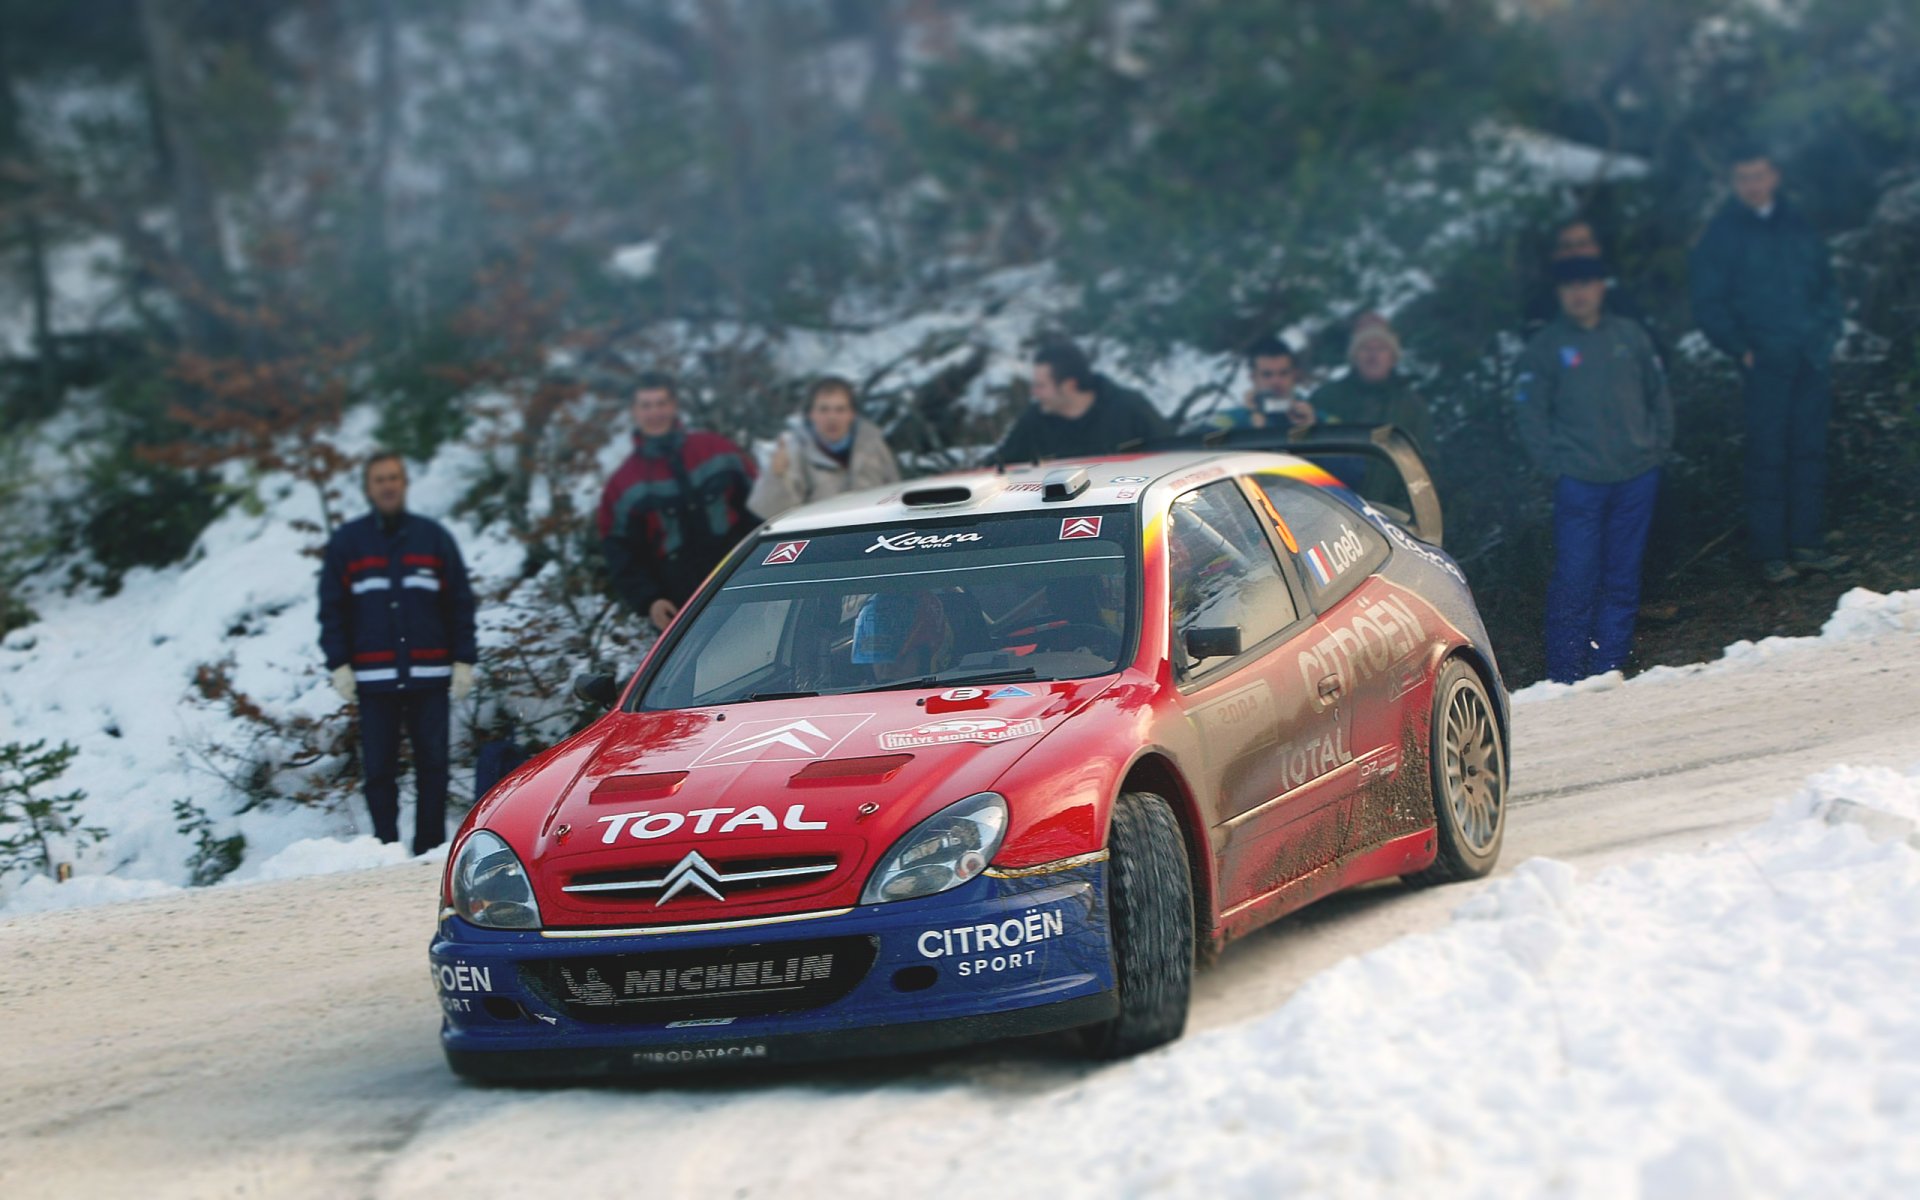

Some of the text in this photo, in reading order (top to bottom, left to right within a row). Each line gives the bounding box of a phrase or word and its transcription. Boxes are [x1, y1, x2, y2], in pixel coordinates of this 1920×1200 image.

[864, 531, 983, 553] Xsara
[1320, 523, 1364, 575] Loeb
[1297, 593, 1426, 714] CITROËN
[886, 732, 936, 749] RALLYE
[1275, 727, 1353, 791] TOTAL
[1361, 760, 1379, 777] OZ
[597, 804, 828, 845] TOTAL
[917, 908, 1064, 959] CITROËN
[624, 954, 834, 994] MICHELIN
[958, 950, 1036, 977] SPORT
